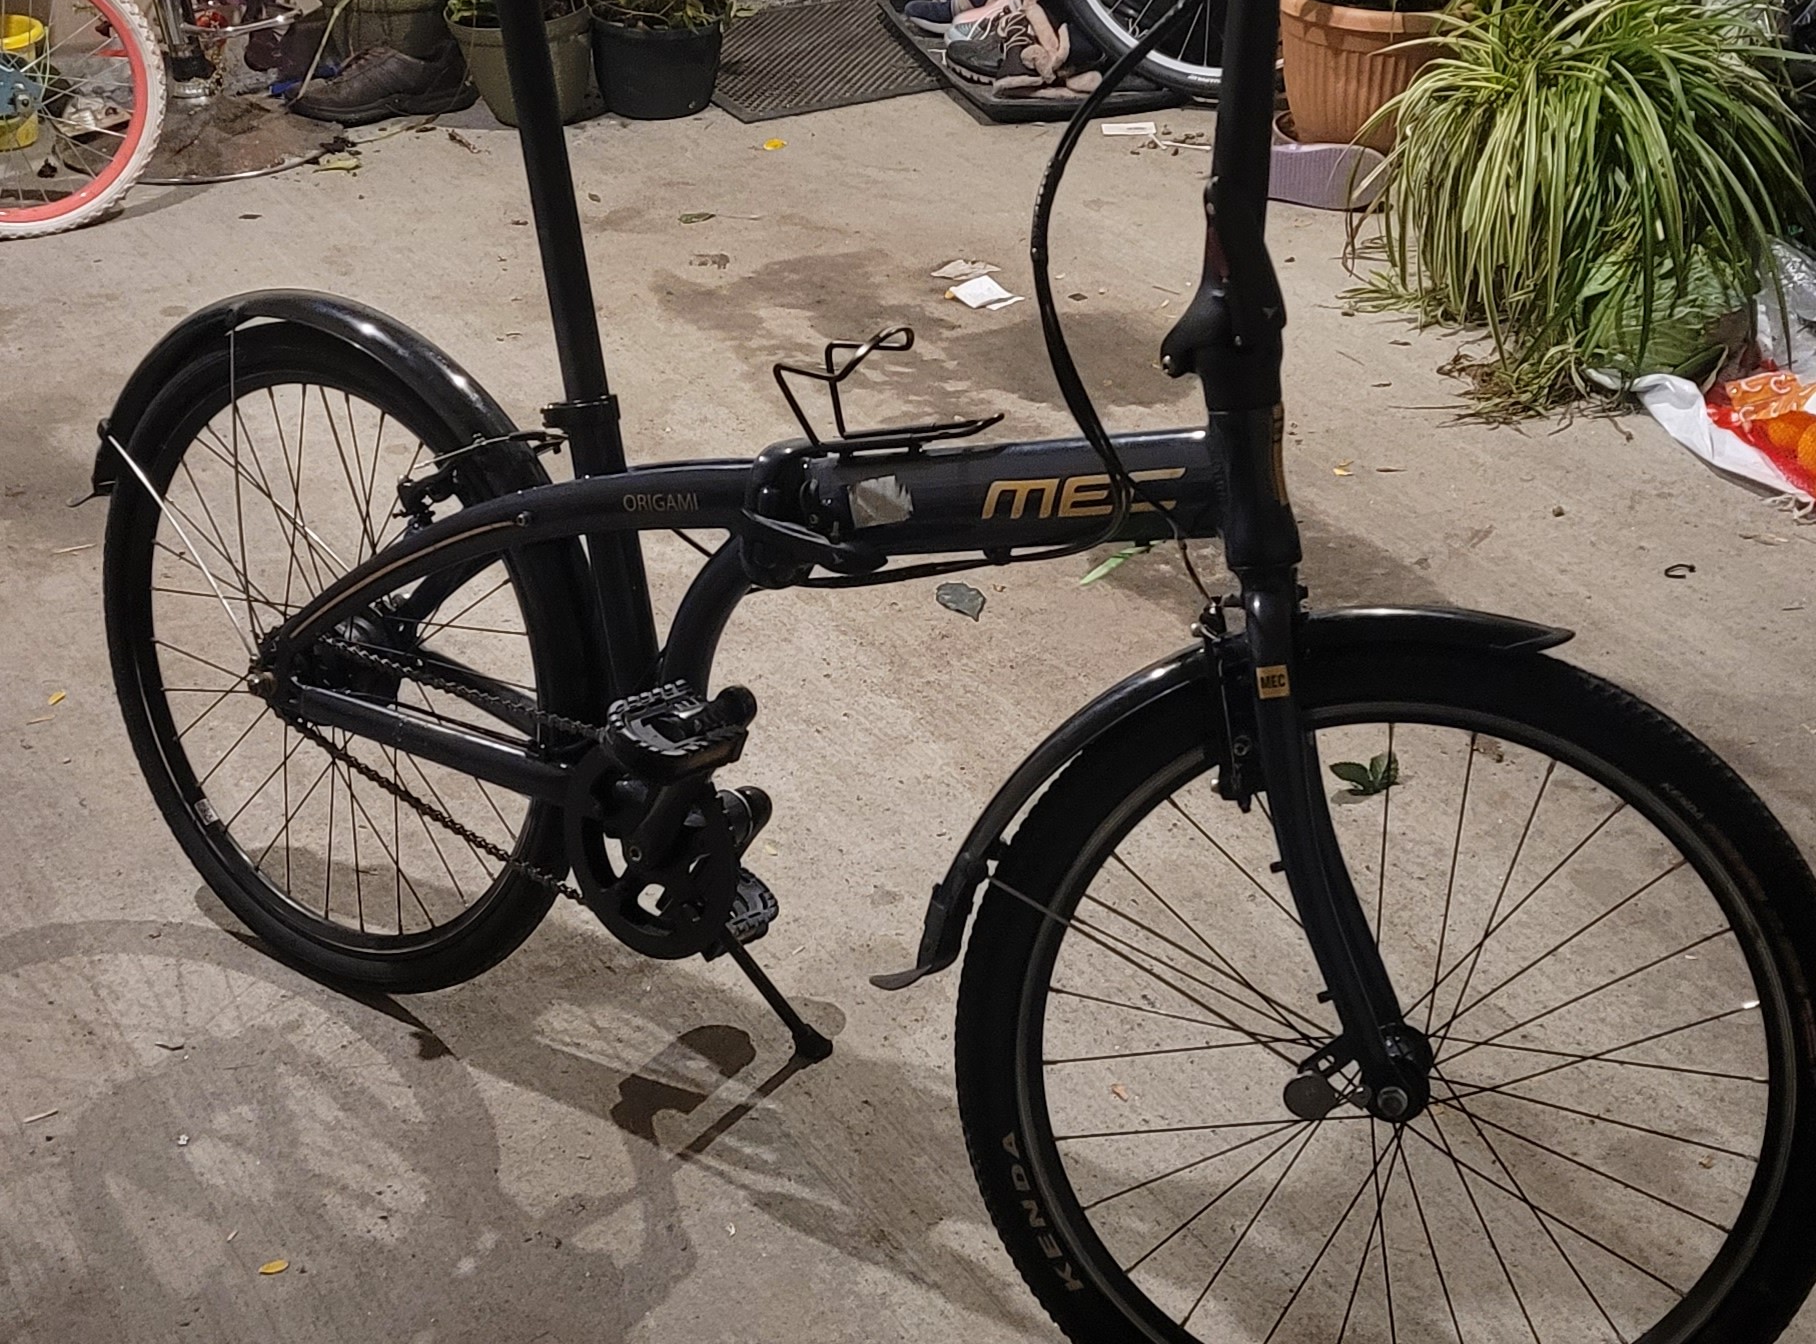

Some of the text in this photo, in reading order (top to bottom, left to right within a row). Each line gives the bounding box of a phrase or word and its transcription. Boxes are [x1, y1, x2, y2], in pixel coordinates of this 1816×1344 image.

[623, 493, 699, 512] ORIGAMI
[981, 467, 1187, 519] MEC
[1260, 673, 1286, 688] MEC
[1002, 1131, 1085, 1292] KENDA
